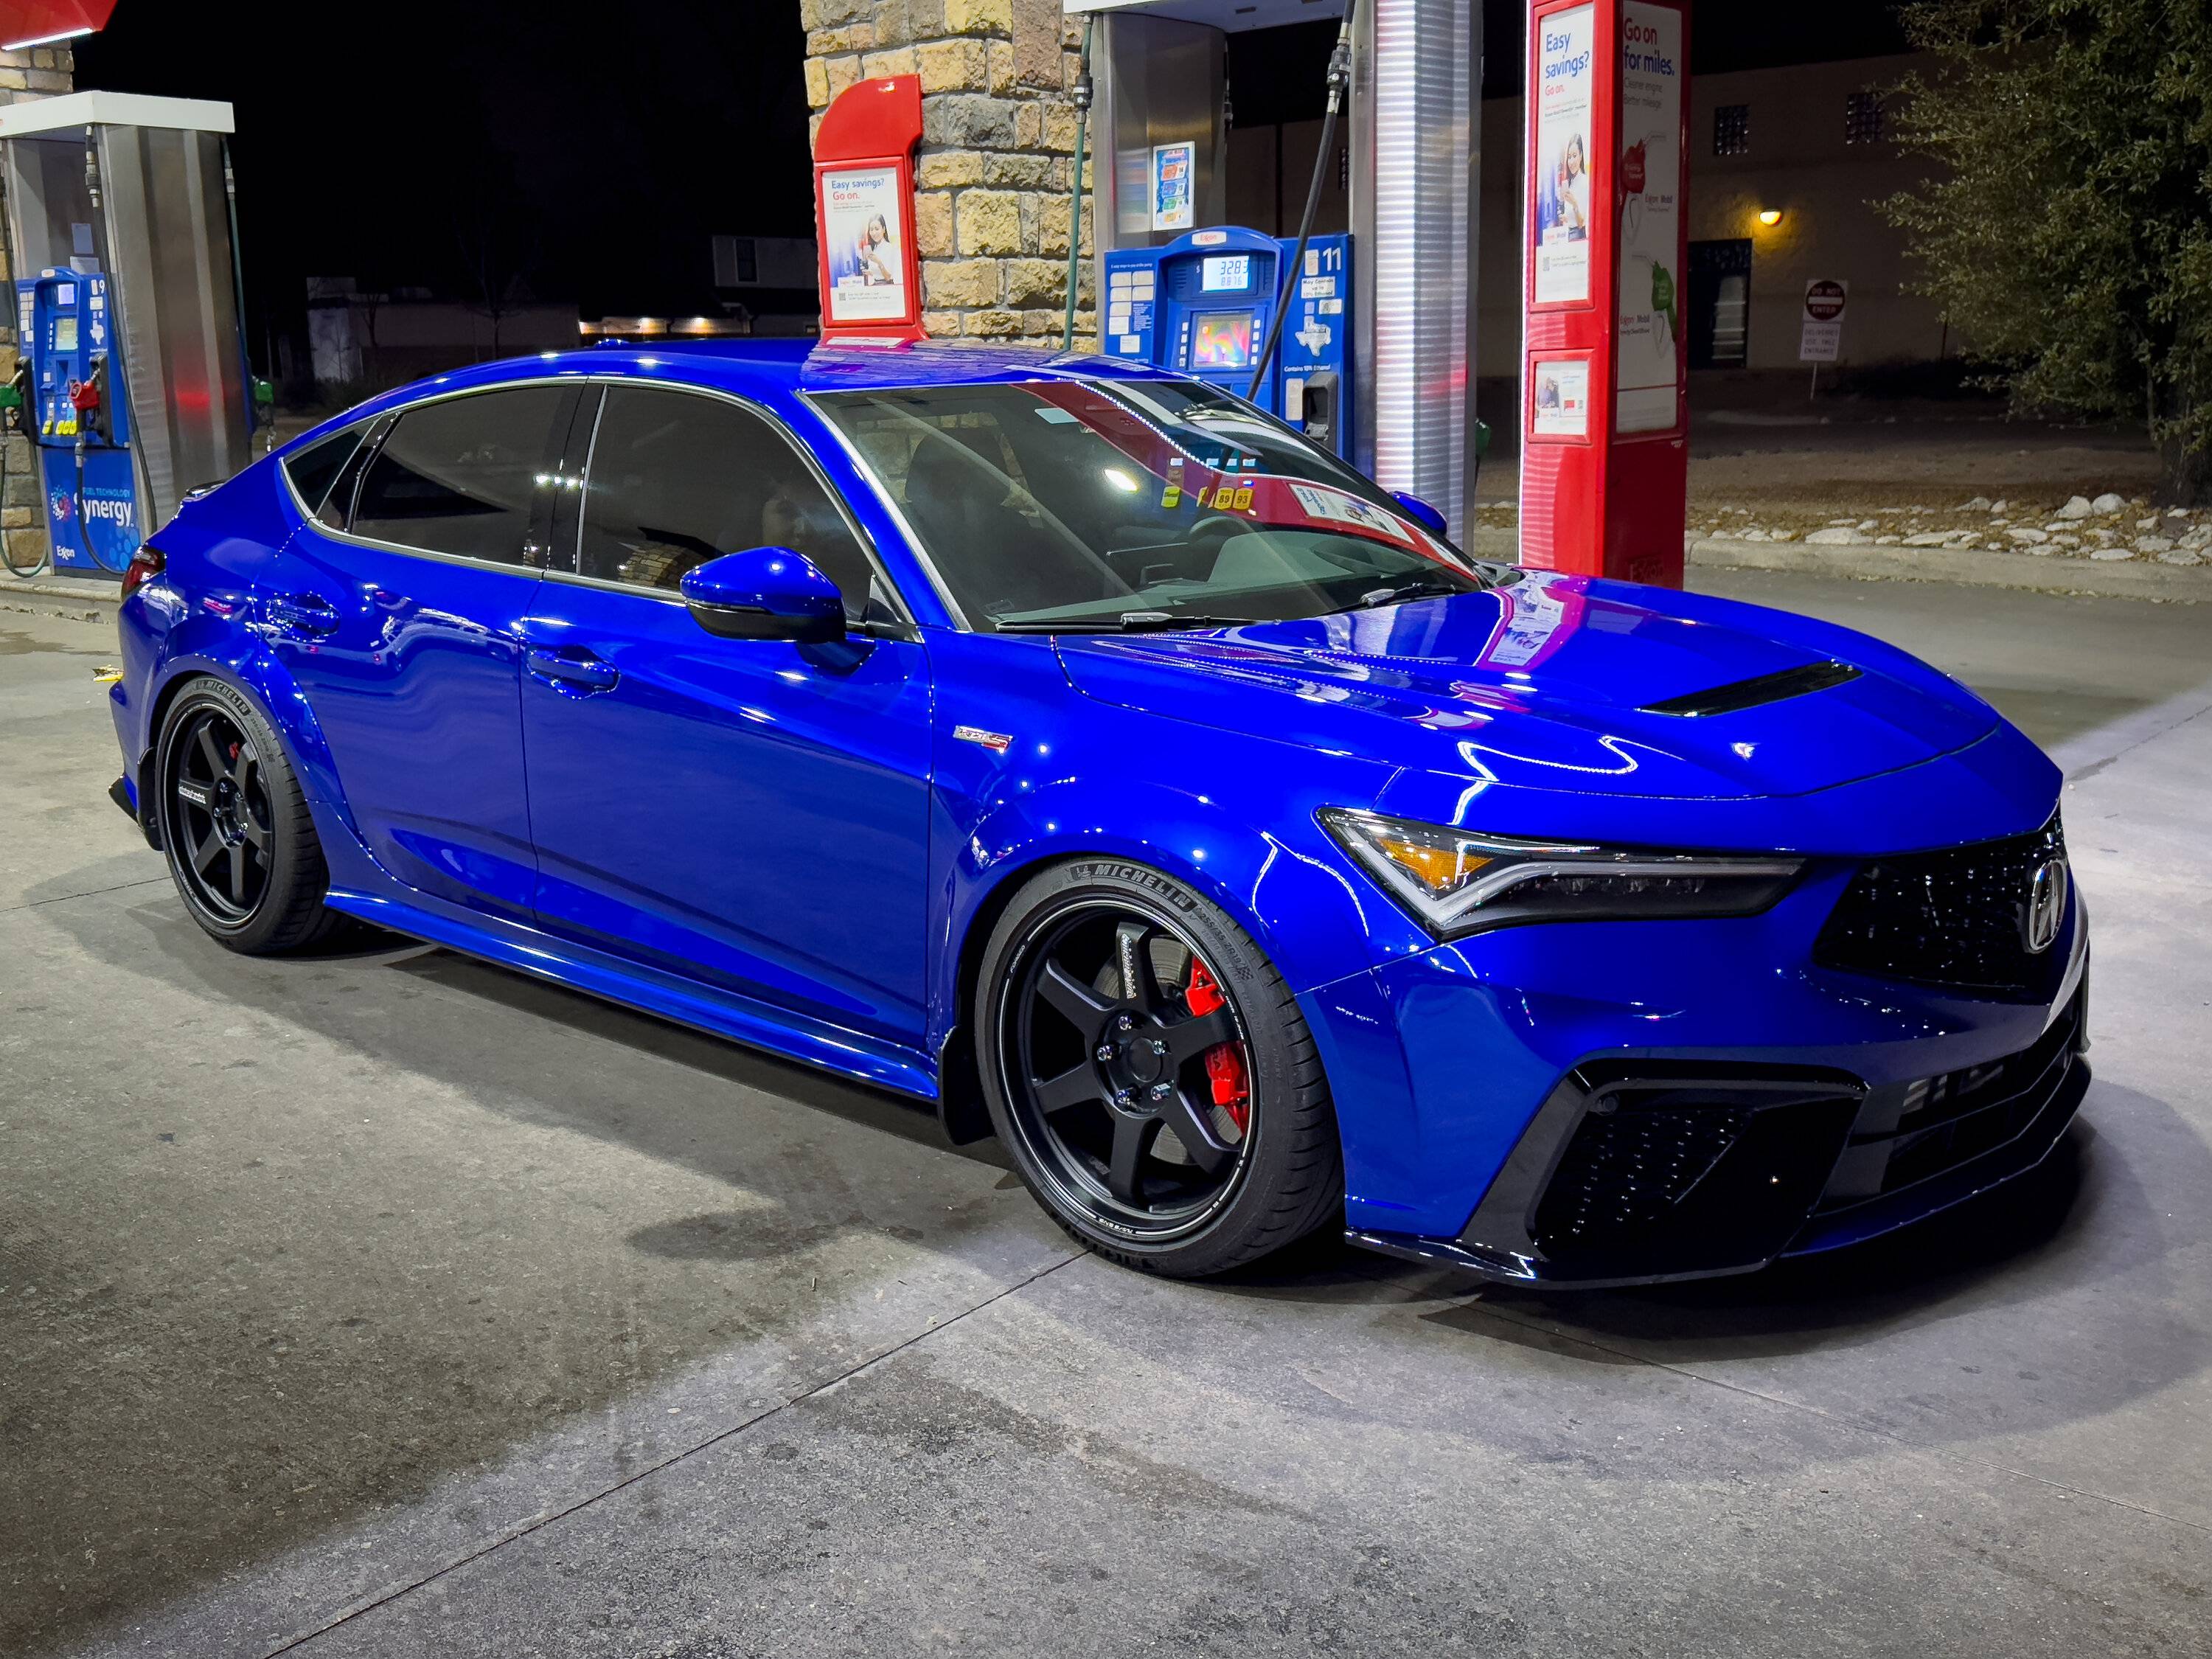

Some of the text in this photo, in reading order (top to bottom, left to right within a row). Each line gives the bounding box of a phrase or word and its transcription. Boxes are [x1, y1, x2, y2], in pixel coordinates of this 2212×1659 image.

[1624, 18, 1657, 45] Go on
[1545, 32, 1571, 53] Easy
[1545, 51, 1589, 79] savings?
[1624, 45, 1674, 76] for miles.
[1545, 84, 1554, 97] Go
[832, 178, 885, 191] Easy savings?
[832, 192, 844, 201] Go
[1323, 247, 1341, 271] 11
[99, 279, 105, 294] 9
[1219, 495, 1230, 504] 89
[1237, 495, 1248, 504] 93
[56, 546, 75, 560] Exxon
[206, 680, 248, 713] MICHELIN
[1095, 864, 1192, 908] MICHELIN
